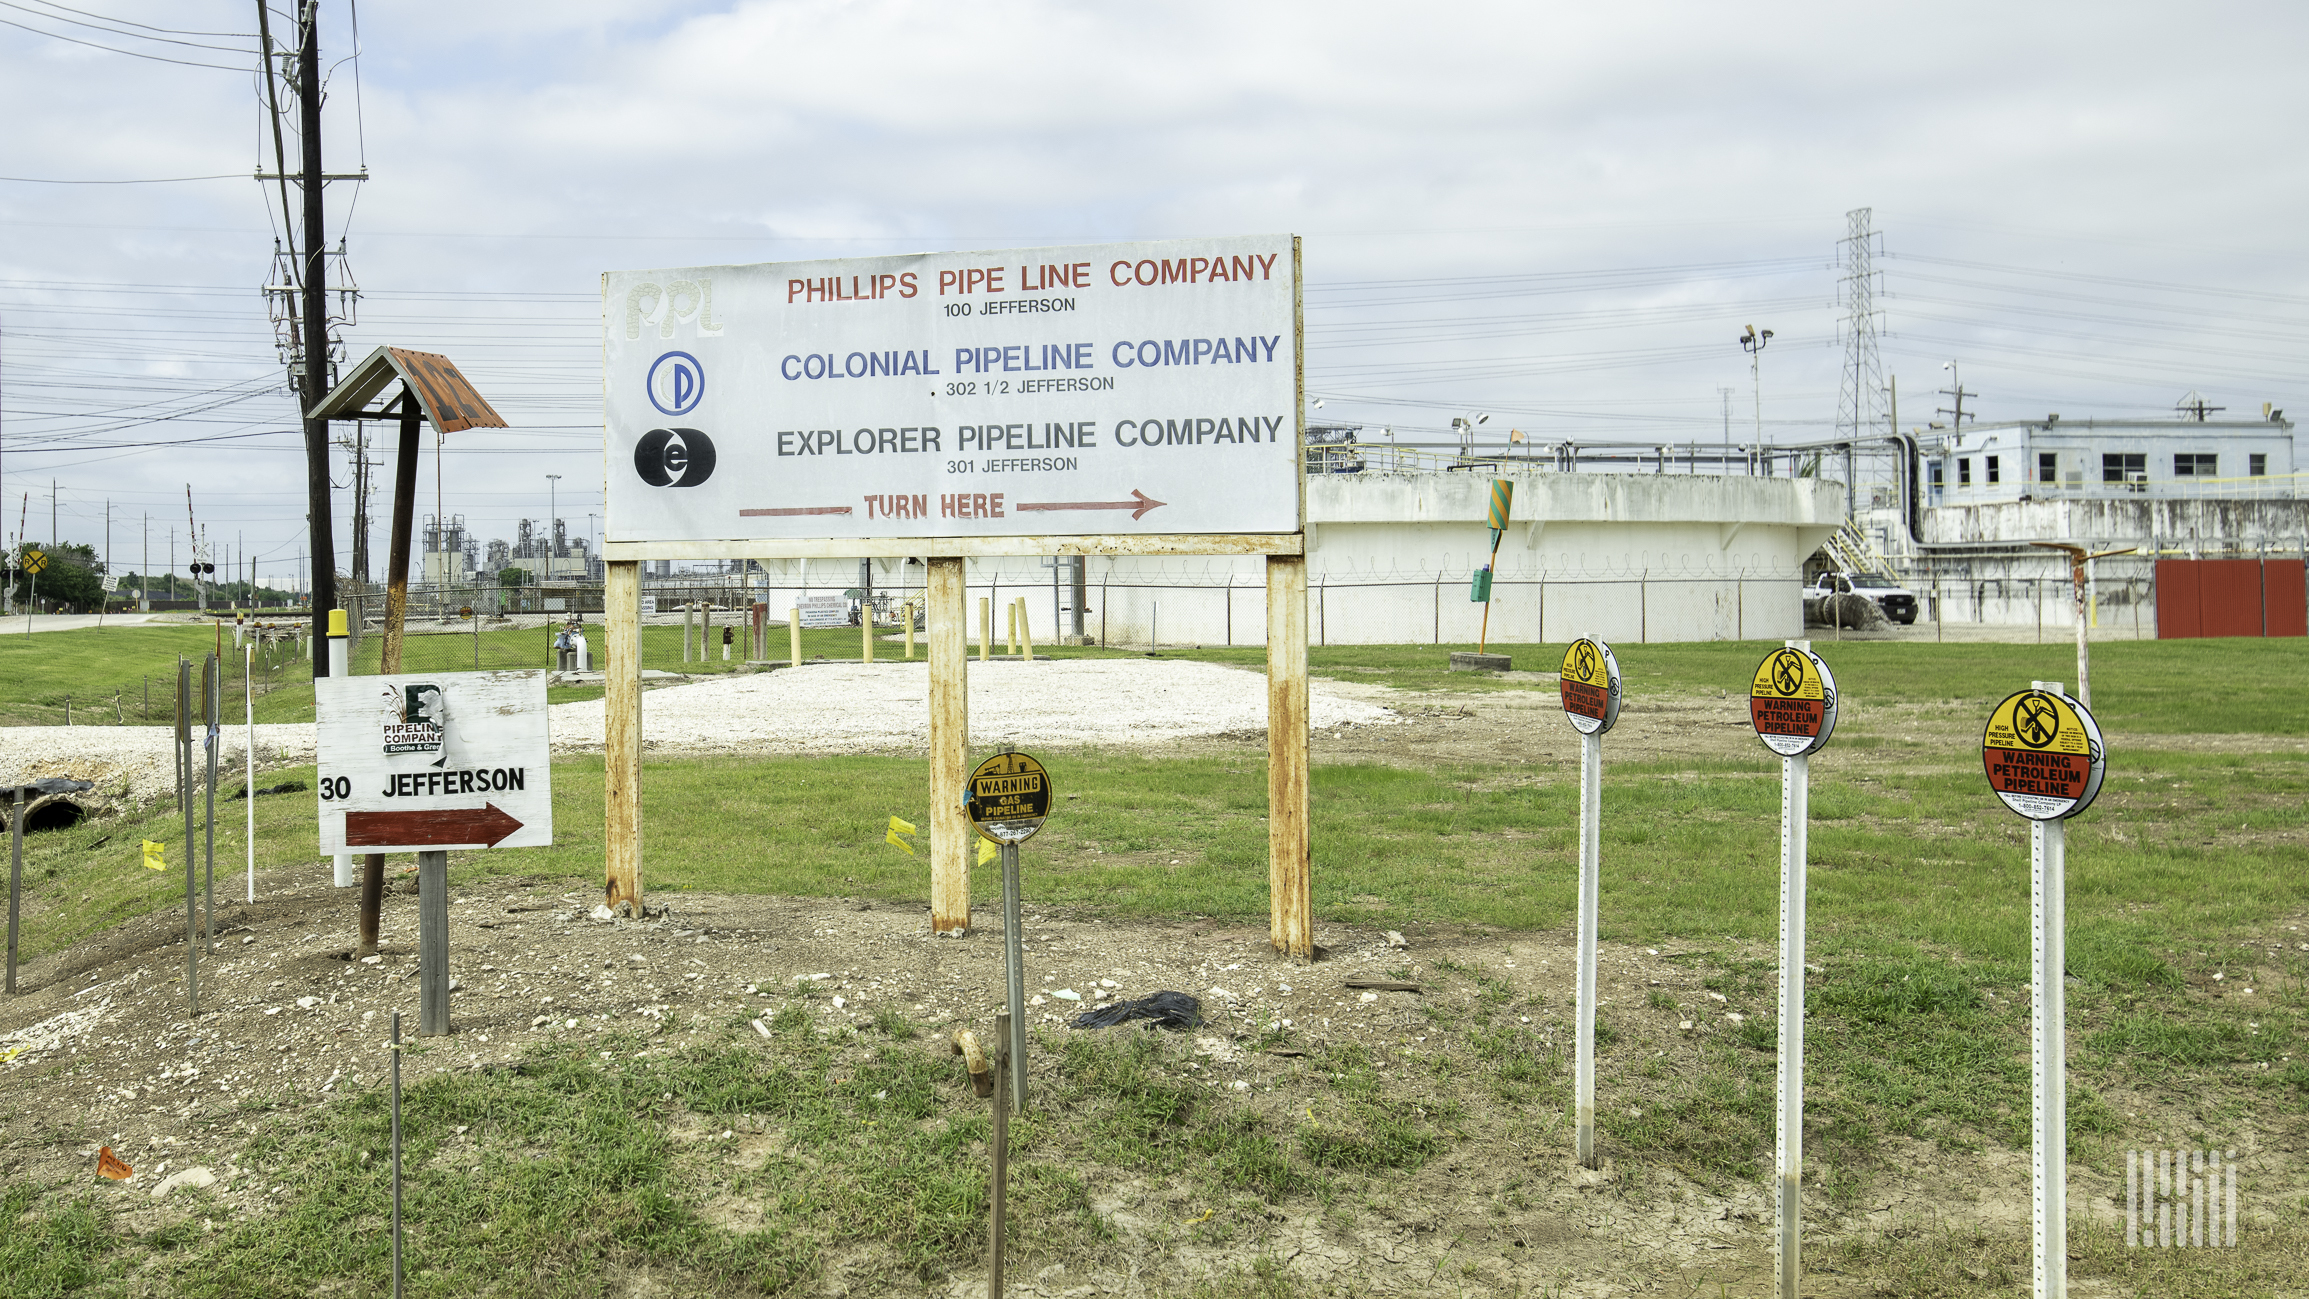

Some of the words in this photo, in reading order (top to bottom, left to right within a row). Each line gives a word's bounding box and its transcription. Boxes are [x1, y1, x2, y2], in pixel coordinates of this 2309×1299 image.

[787, 272, 918, 304] PHILLIPS
[939, 266, 1005, 296] PIPE
[1021, 262, 1091, 291] LINE
[1109, 253, 1278, 287] COMPANY
[943, 302, 972, 317] 100
[979, 297, 1076, 316] JEFFERSON
[780, 350, 940, 381] COLONIAL
[955, 342, 1094, 374] PIPELINE
[1111, 335, 1281, 369] COMPANY
[946, 381, 977, 396] 302
[983, 379, 1009, 396] 1/2
[1017, 376, 1114, 393] JEFFERSON
[777, 426, 941, 457] EXPLORER
[958, 421, 1097, 451] PIPELINE
[1114, 415, 1284, 448] COMPANY
[946, 460, 975, 474] 301
[981, 456, 1078, 473] JEFFERSON
[864, 493, 928, 519] TURN
[940, 493, 1005, 519] HERE
[1569, 682, 1600, 698] WARNING
[1564, 691, 1604, 708] PETROLEUM
[1764, 699, 1811, 712] WARNING
[1569, 701, 1599, 718] PIPELINE
[1757, 710, 1818, 724] PETROLEUM
[1764, 721, 1810, 735] PIPELINE
[1988, 732, 2016, 740] PRESSURE
[1995, 724, 2009, 732] HIGH
[384, 733, 443, 744] COMPANY
[1990, 739, 2014, 747] PIPELINE
[2002, 751, 2072, 769] WARNING
[1993, 763, 2081, 784] PETROLEUM
[320, 776, 351, 801] 30
[382, 767, 525, 798] JEFFERSON
[980, 776, 1038, 794] WARNING
[2004, 778, 2070, 796] PIPELINE
[1000, 795, 1020, 806] GAS
[985, 803, 1034, 816] PIPELINE
